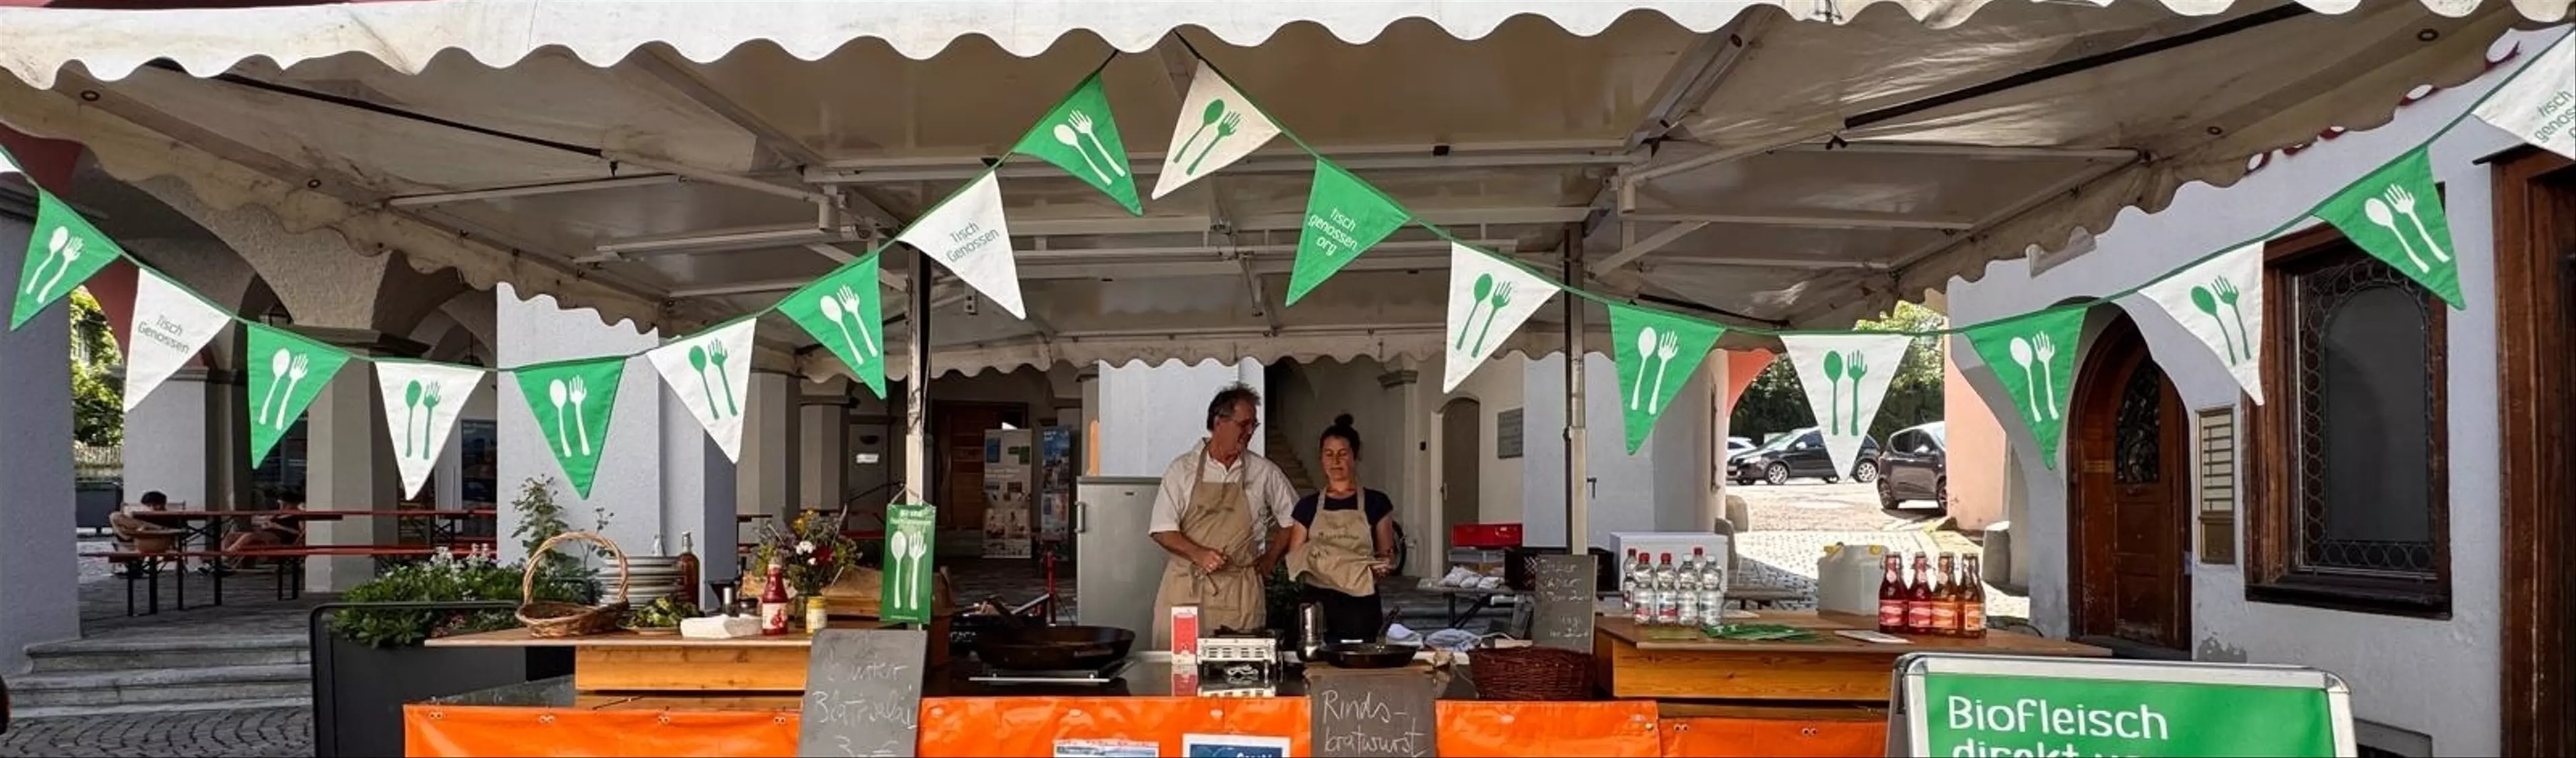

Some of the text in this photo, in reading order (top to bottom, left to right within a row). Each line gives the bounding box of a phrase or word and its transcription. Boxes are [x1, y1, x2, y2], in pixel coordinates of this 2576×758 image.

[2534, 105, 2575, 143] genos
[946, 229, 1000, 263] Genossen
[1308, 215, 1358, 251] genossen
[1316, 237, 1338, 256] org
[138, 321, 190, 354] Genossen
[1322, 689, 1407, 724] Rinds-
[1948, 695, 2169, 740] Biofleisch
[1324, 717, 1430, 757] bratwurst
